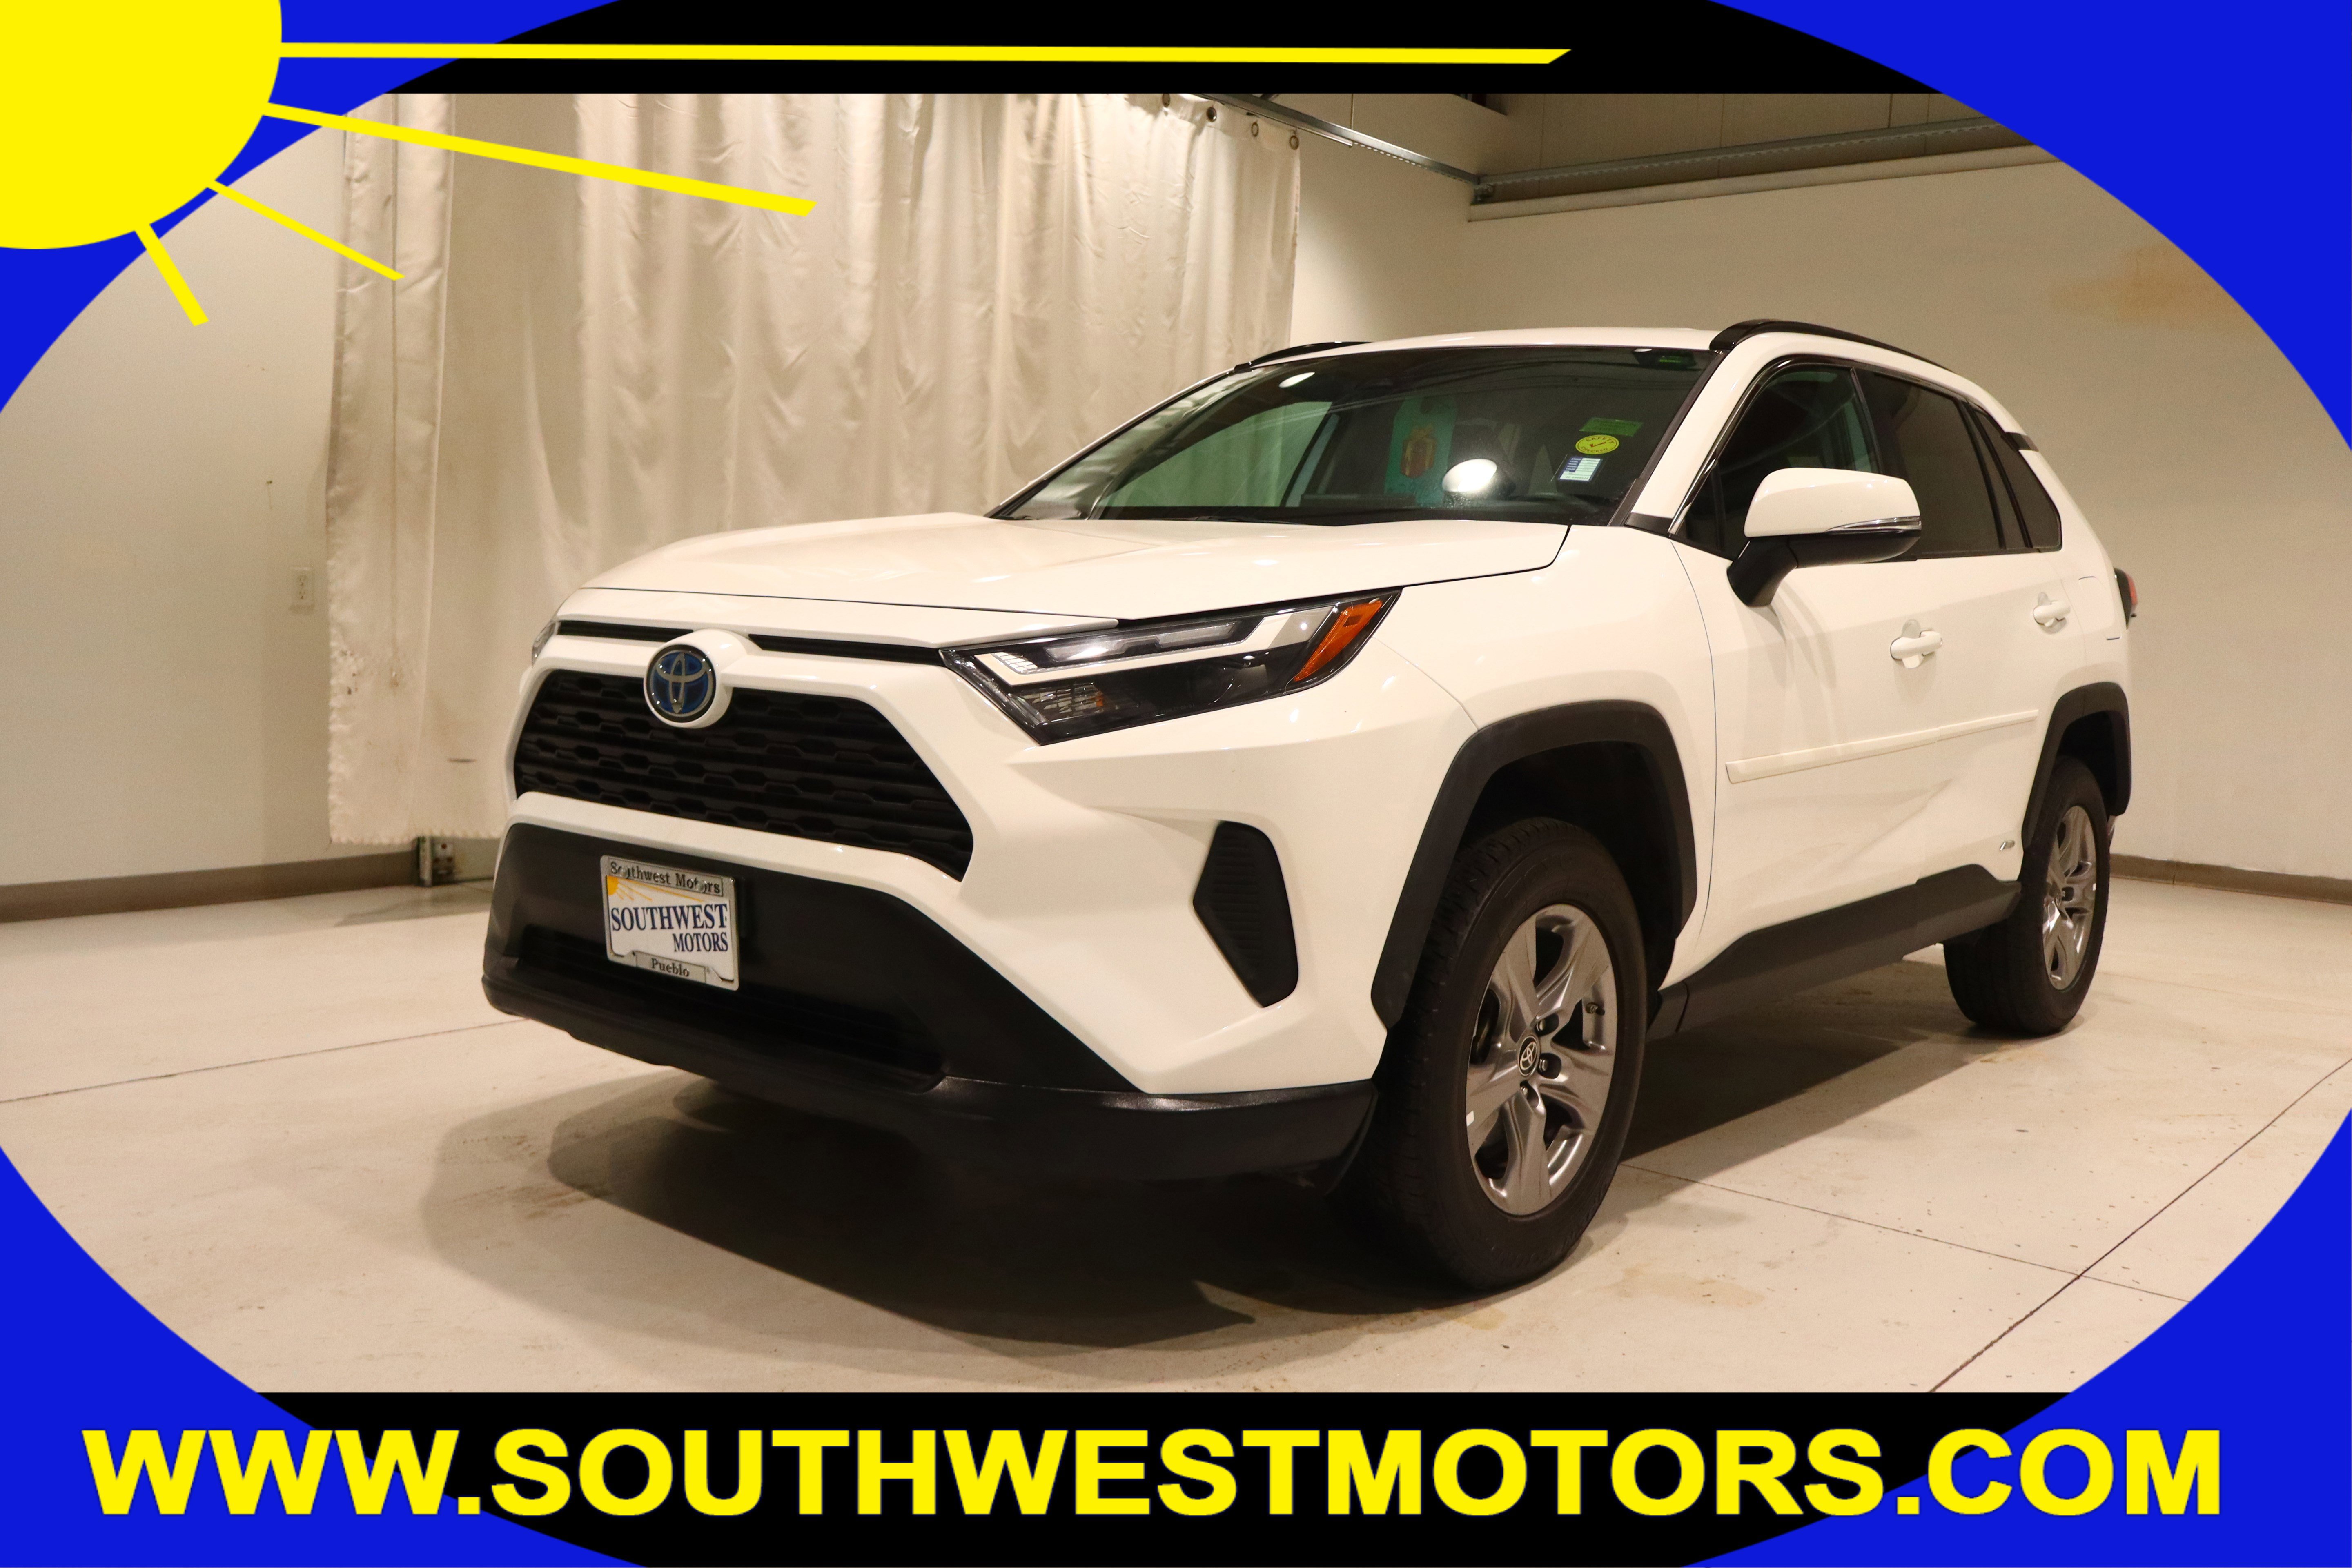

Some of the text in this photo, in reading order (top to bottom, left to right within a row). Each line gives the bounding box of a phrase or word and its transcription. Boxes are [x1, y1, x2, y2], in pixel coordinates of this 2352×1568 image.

[611, 903, 727, 931] SOUTHWEST
[673, 932, 728, 952] MOTORS
[651, 958, 690, 977] Pueblo
